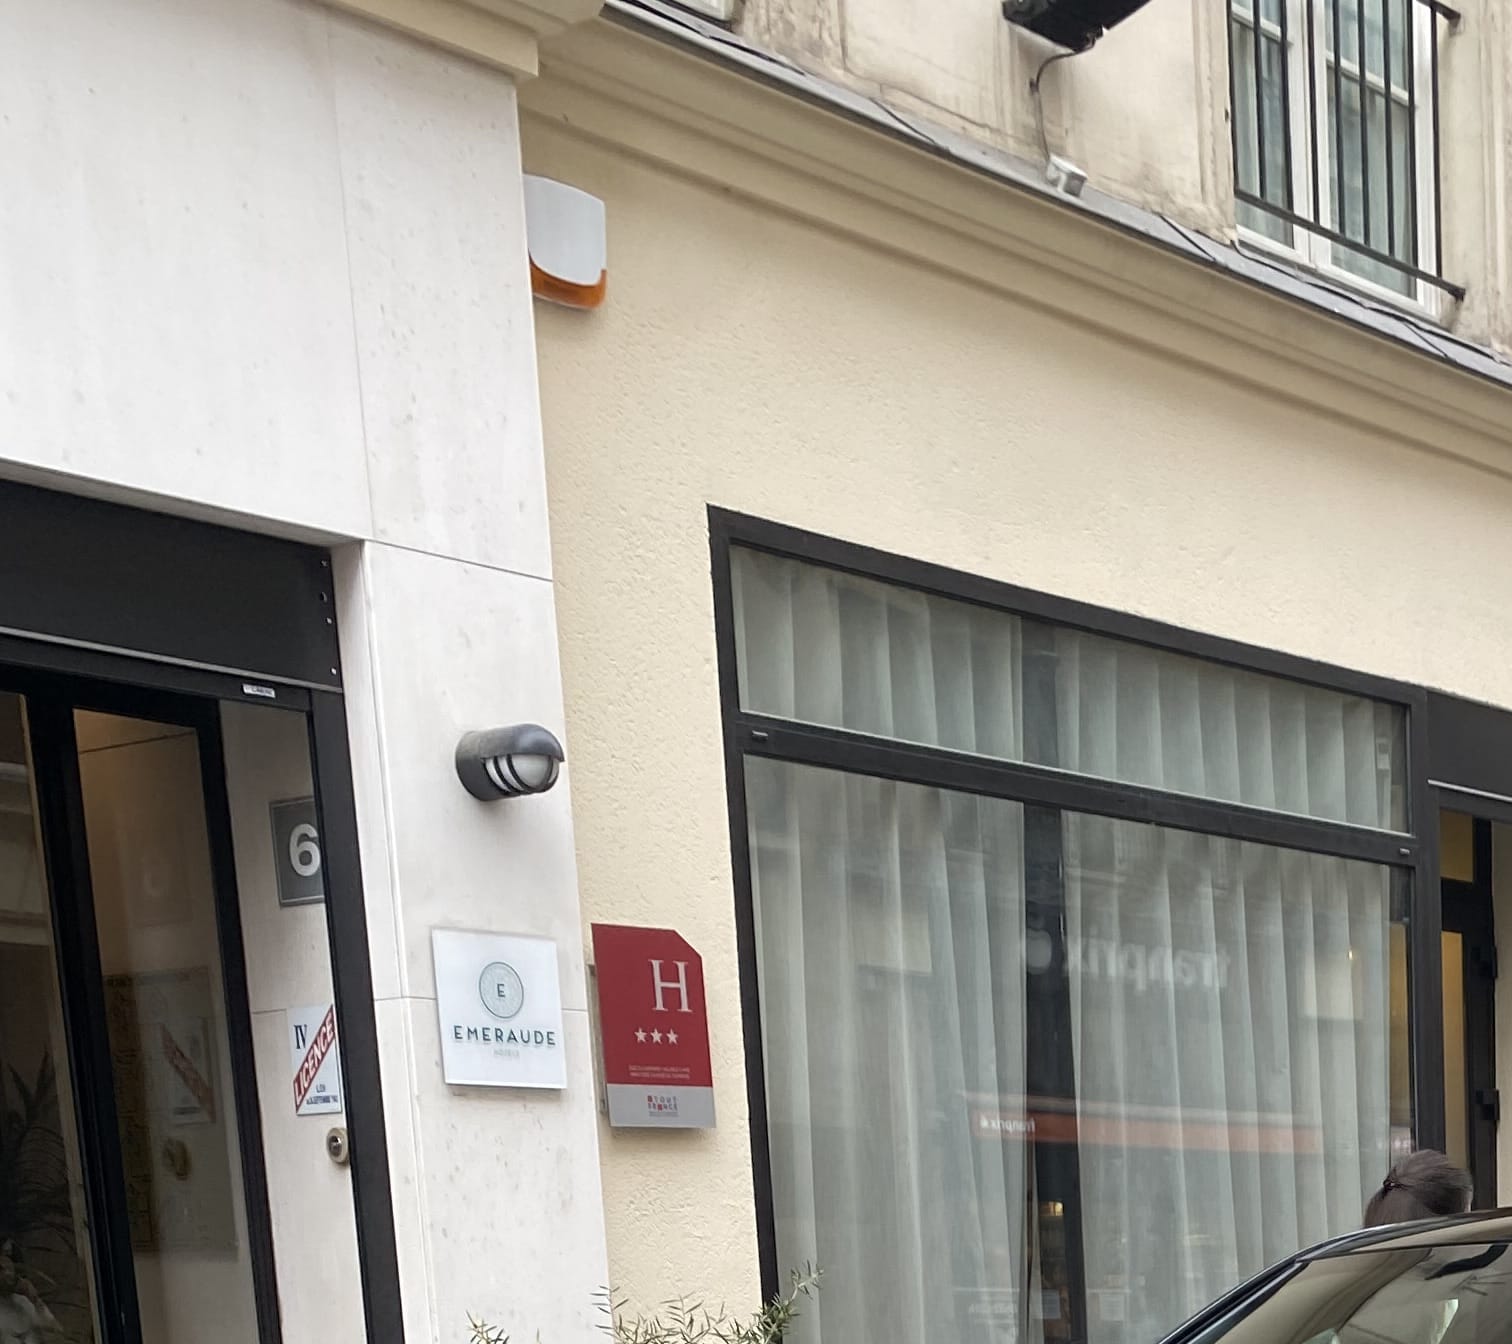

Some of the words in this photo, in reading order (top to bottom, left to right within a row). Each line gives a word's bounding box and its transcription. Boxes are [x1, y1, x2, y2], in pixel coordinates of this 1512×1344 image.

[288, 823, 321, 877] 6
[497, 984, 506, 998] E
[649, 959, 693, 1013] H
[294, 1024, 308, 1050] IV
[453, 1025, 556, 1046] EMERAUDE
[294, 1012, 335, 1105] LICENCE
